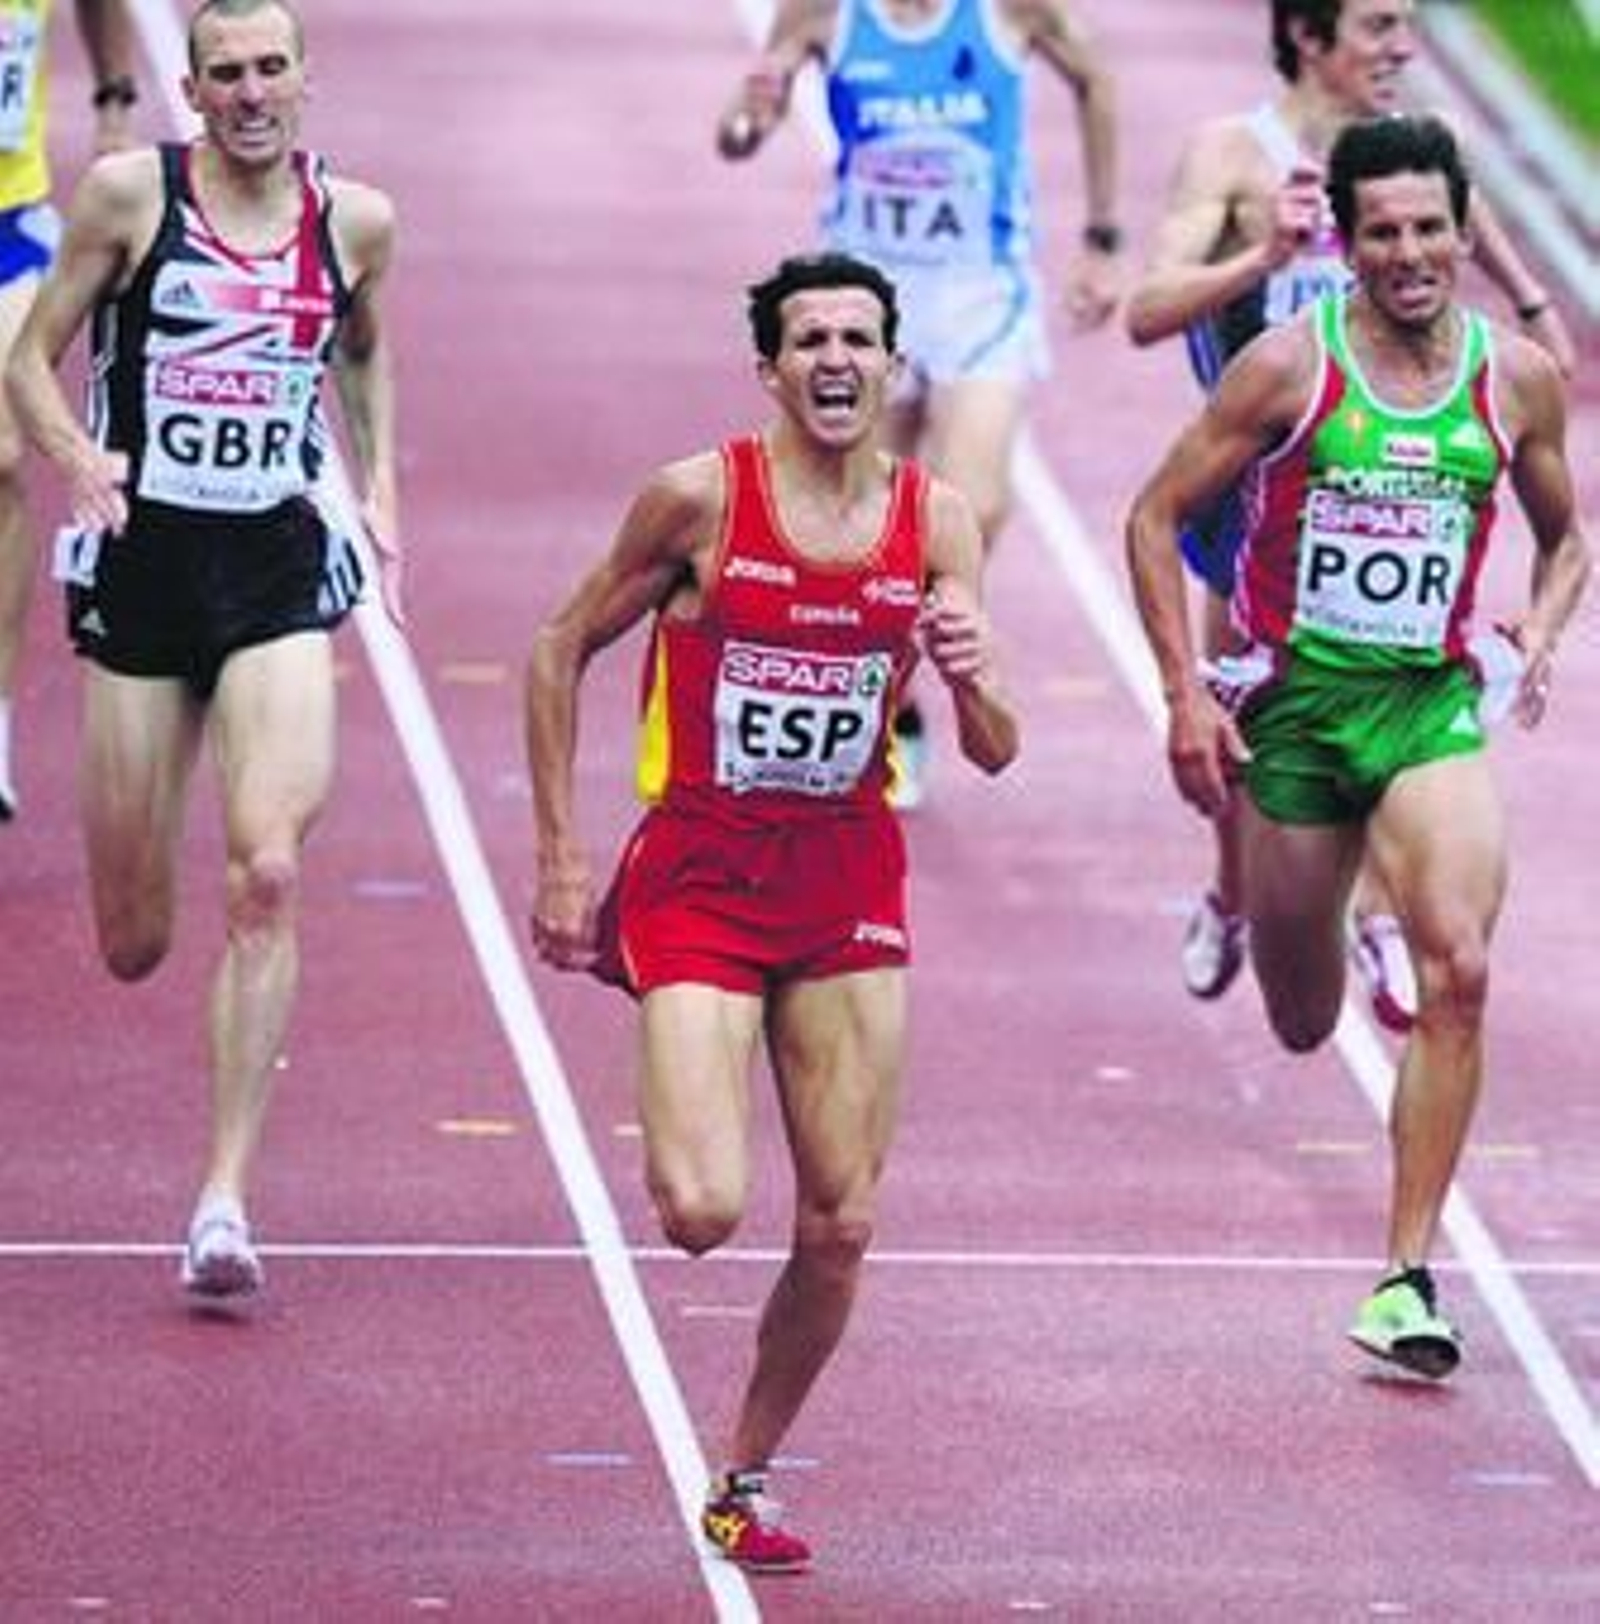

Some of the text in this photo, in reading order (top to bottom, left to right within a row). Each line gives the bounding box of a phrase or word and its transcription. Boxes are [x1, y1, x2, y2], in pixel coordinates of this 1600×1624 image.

[3, 65, 23, 111] R
[863, 195, 963, 240] ITA
[160, 369, 274, 402] SPAR
[160, 413, 291, 468] GBR
[1312, 497, 1430, 538] SPAR
[1307, 545, 1451, 606] POR
[726, 653, 851, 692] SPAR
[739, 699, 863, 762] ESP
